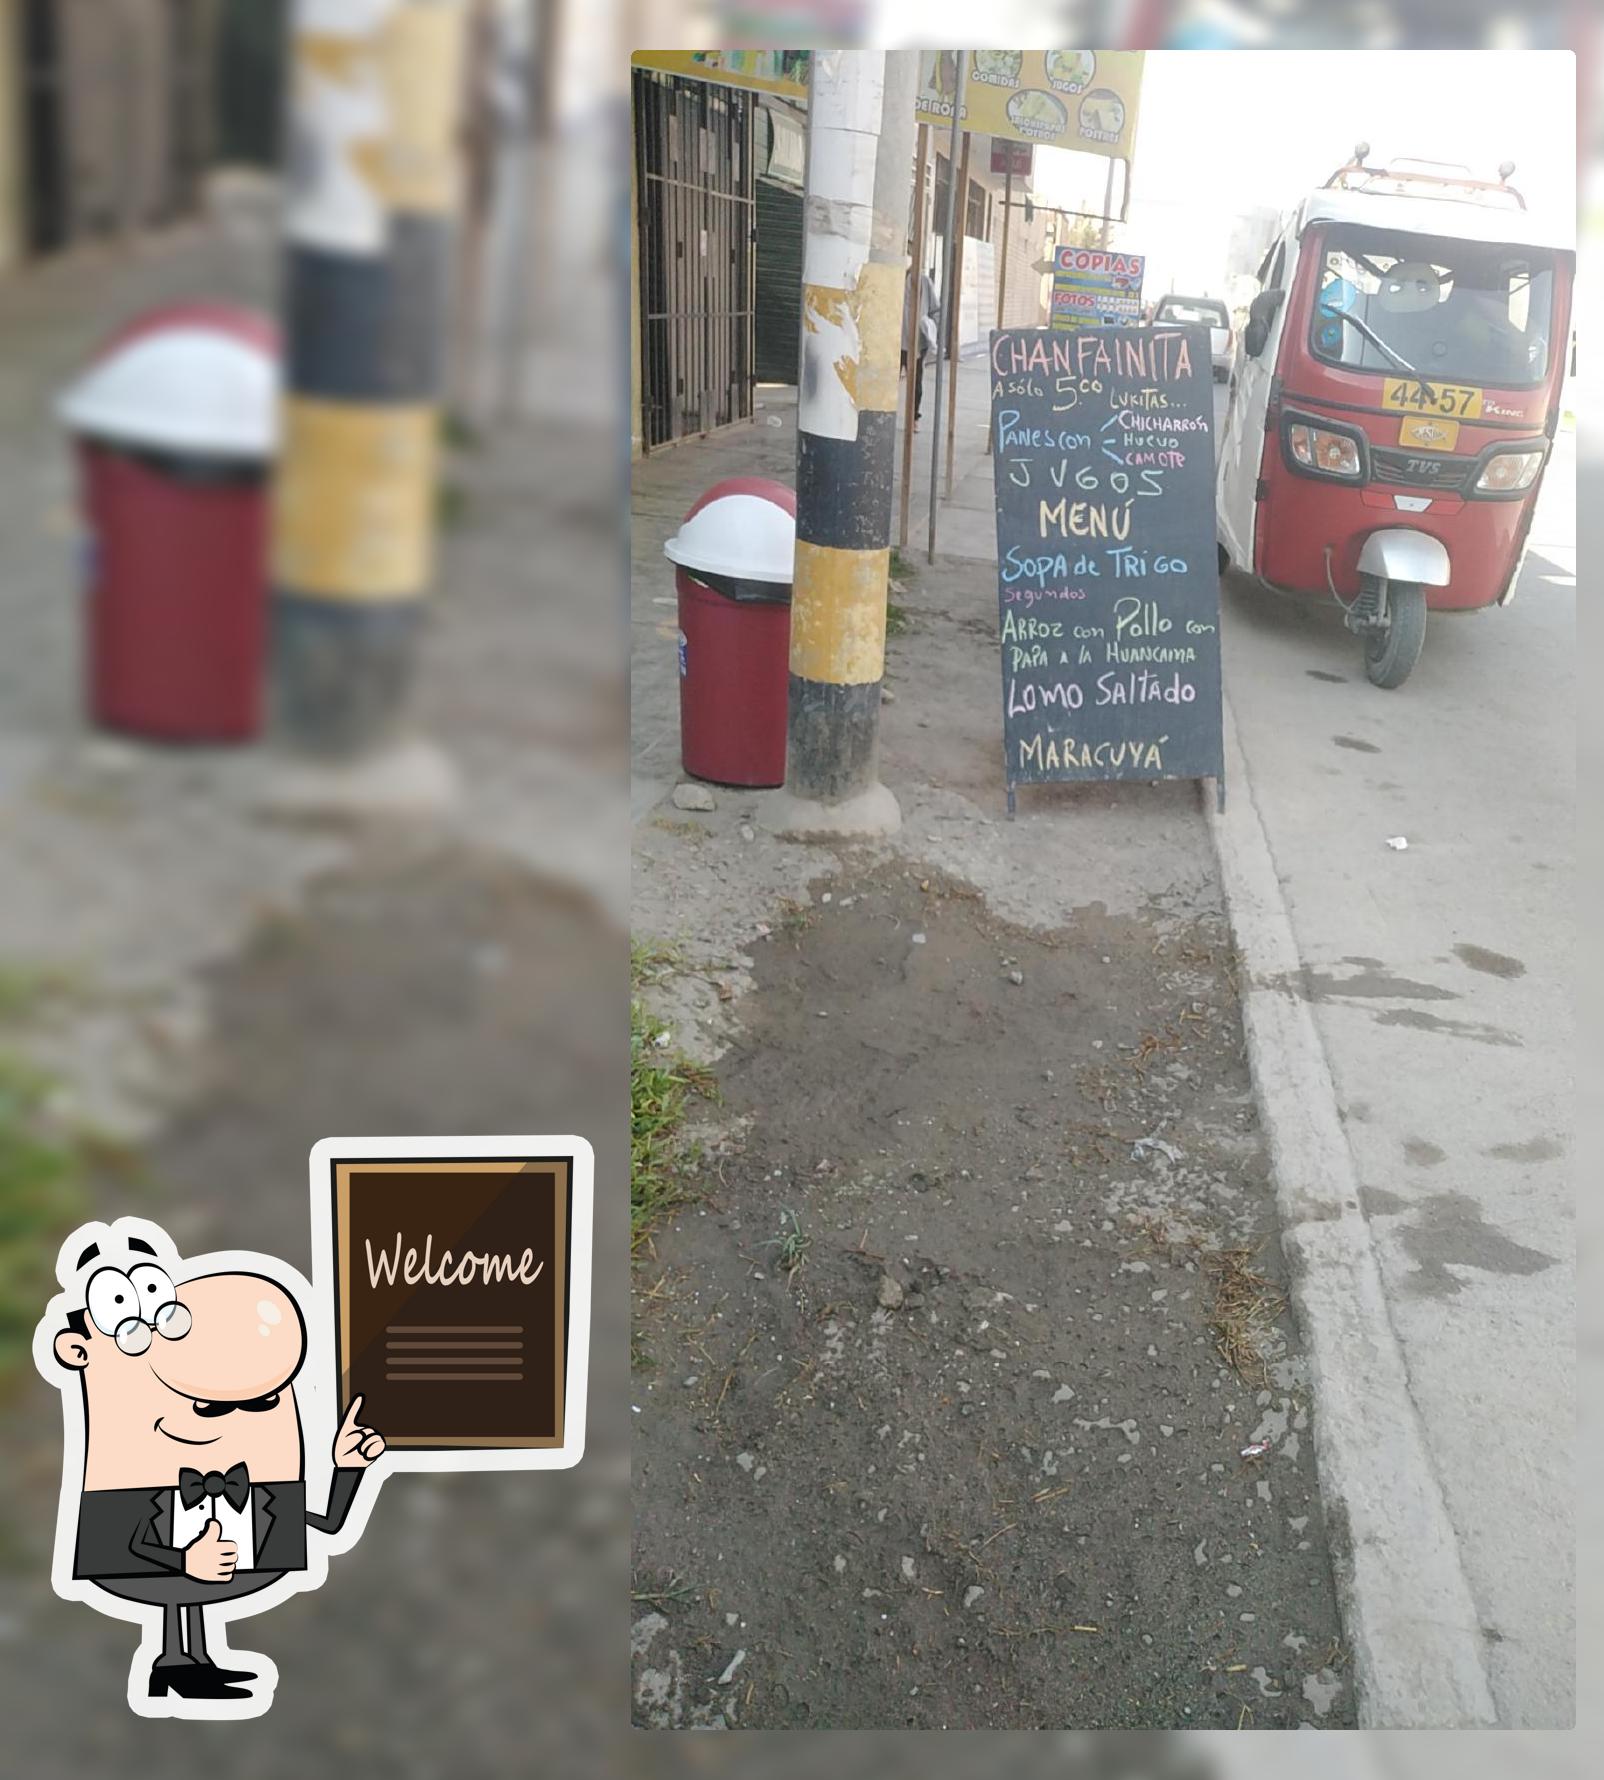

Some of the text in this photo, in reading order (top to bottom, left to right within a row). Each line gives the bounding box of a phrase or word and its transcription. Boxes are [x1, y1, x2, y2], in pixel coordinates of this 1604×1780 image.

[971, 70, 1020, 89] COMIDAS
[1052, 79, 1083, 95] JUGOS
[1059, 248, 1143, 277] COPIAS
[1053, 292, 1097, 309] FOTOS
[992, 332, 1193, 381] CHANFAINITA
[992, 381, 1004, 400] A
[1405, 459, 1441, 474] TVS
[1039, 496, 1135, 541] MENÚ
[1002, 545, 1068, 588] SOPA
[1074, 554, 1100, 577] de
[1004, 586, 1087, 609] Segundos
[1073, 625, 1105, 639] con
[1114, 596, 1173, 641] Pollo
[1186, 619, 1216, 634] con
[1010, 644, 1048, 672] PAPA
[1019, 733, 1170, 771] MARACUYÁ
